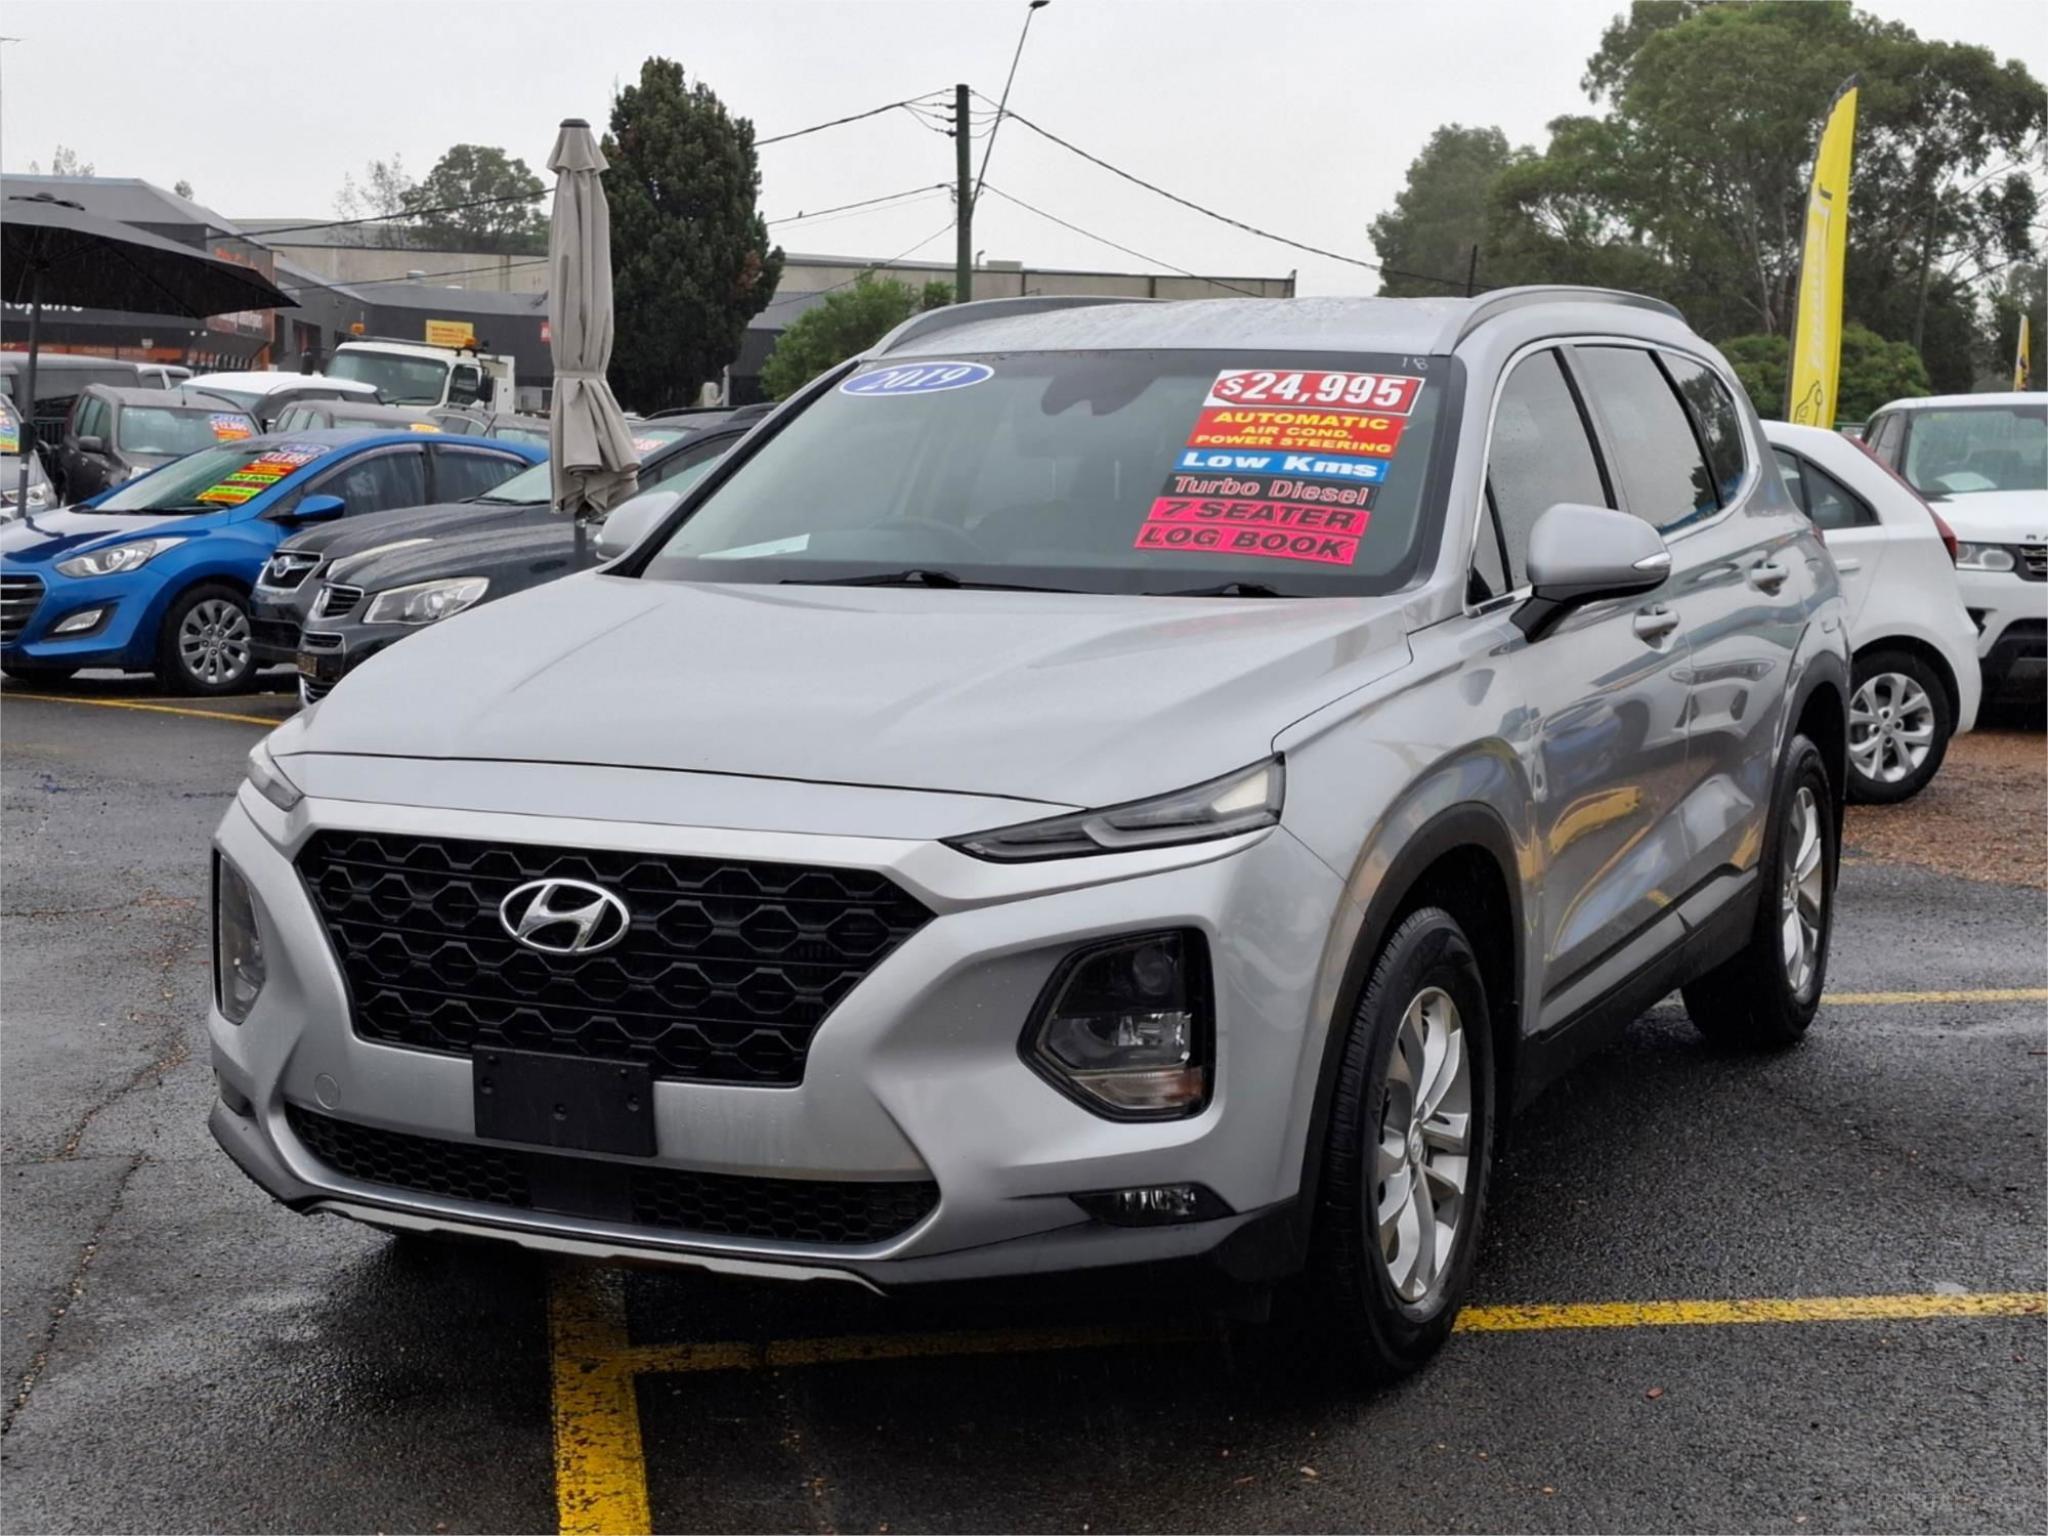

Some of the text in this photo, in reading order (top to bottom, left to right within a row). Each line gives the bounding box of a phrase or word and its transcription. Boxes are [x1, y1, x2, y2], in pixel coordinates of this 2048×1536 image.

[855, 366, 972, 391] 2019
[1220, 372, 1407, 407] $24,995
[1213, 411, 1390, 430] AUTOMATIC
[1241, 425, 1353, 439] AIR COND.
[1195, 435, 1392, 453] POWER STEERING
[1182, 452, 1378, 477] Low Kms
[1175, 476, 1369, 506] Turbo Diesel
[1162, 501, 1357, 529] 7 SEATER
[1141, 526, 1352, 558] LOG BOOK
